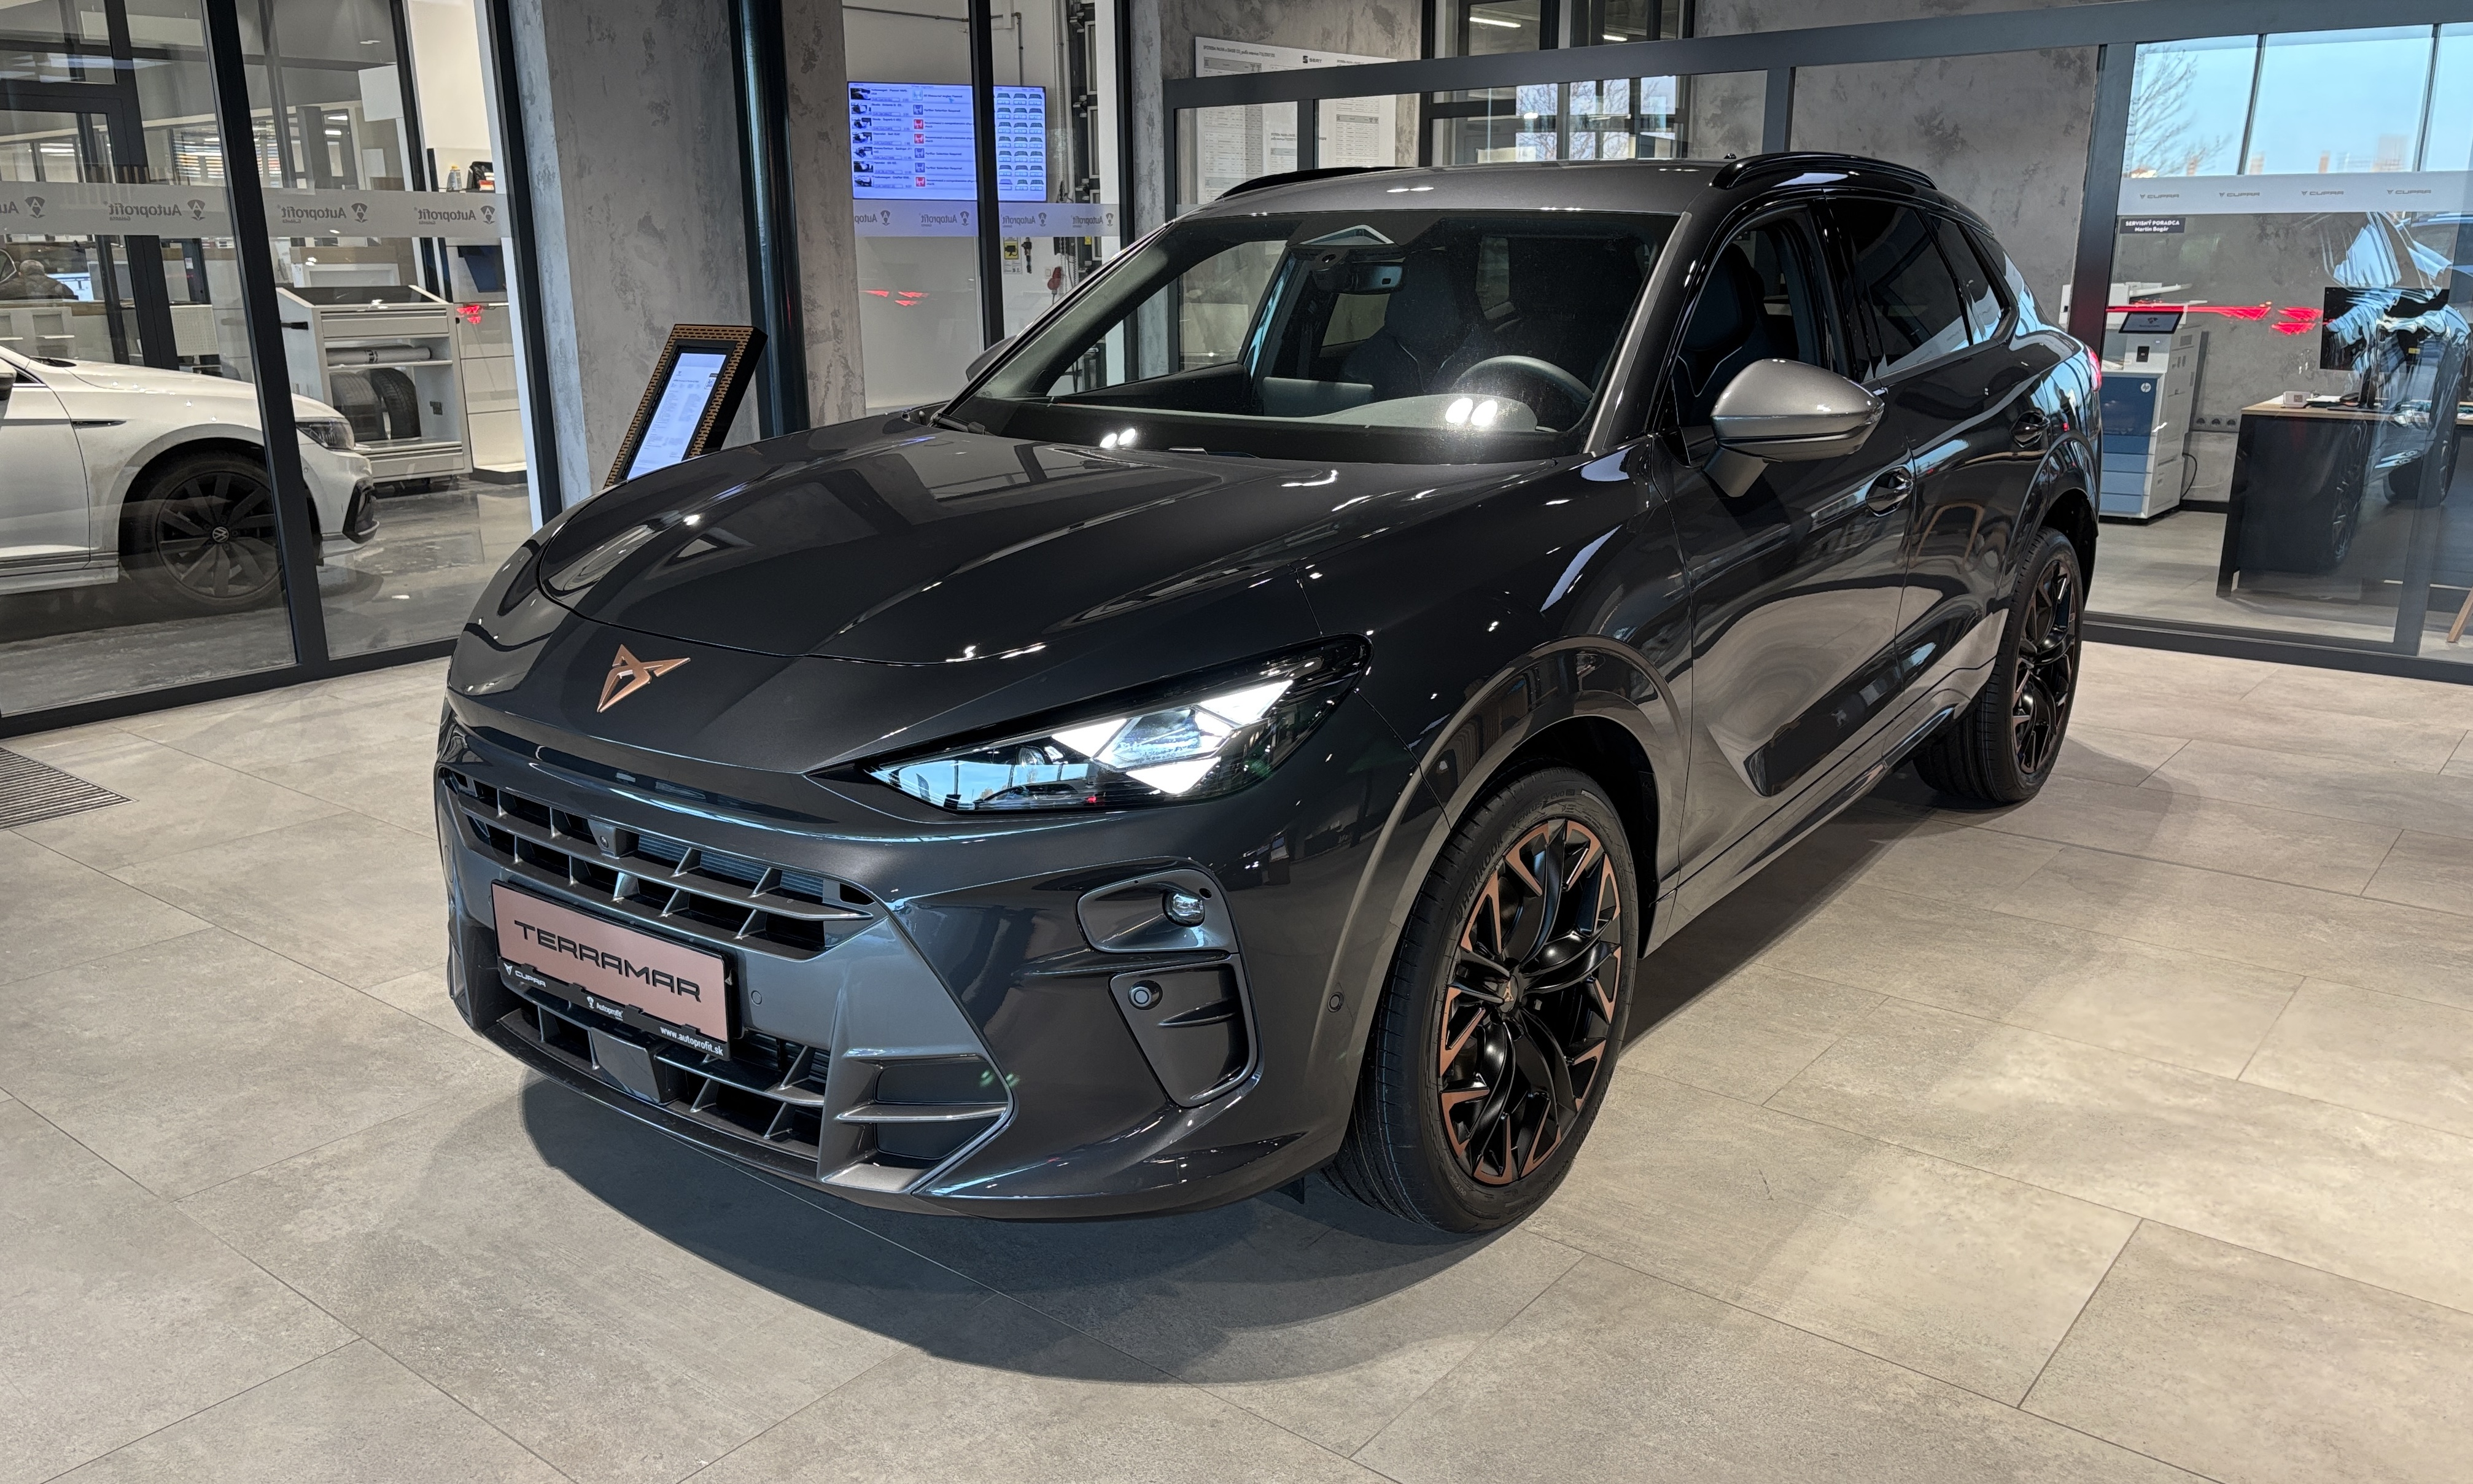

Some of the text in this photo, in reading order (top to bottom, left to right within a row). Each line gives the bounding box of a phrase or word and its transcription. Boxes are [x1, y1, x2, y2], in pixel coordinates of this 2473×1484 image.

[514, 920, 702, 1003] TERRAMAR
[514, 970, 546, 987] CUPRA
[659, 1026, 724, 1056] www.autoprofit.sk
